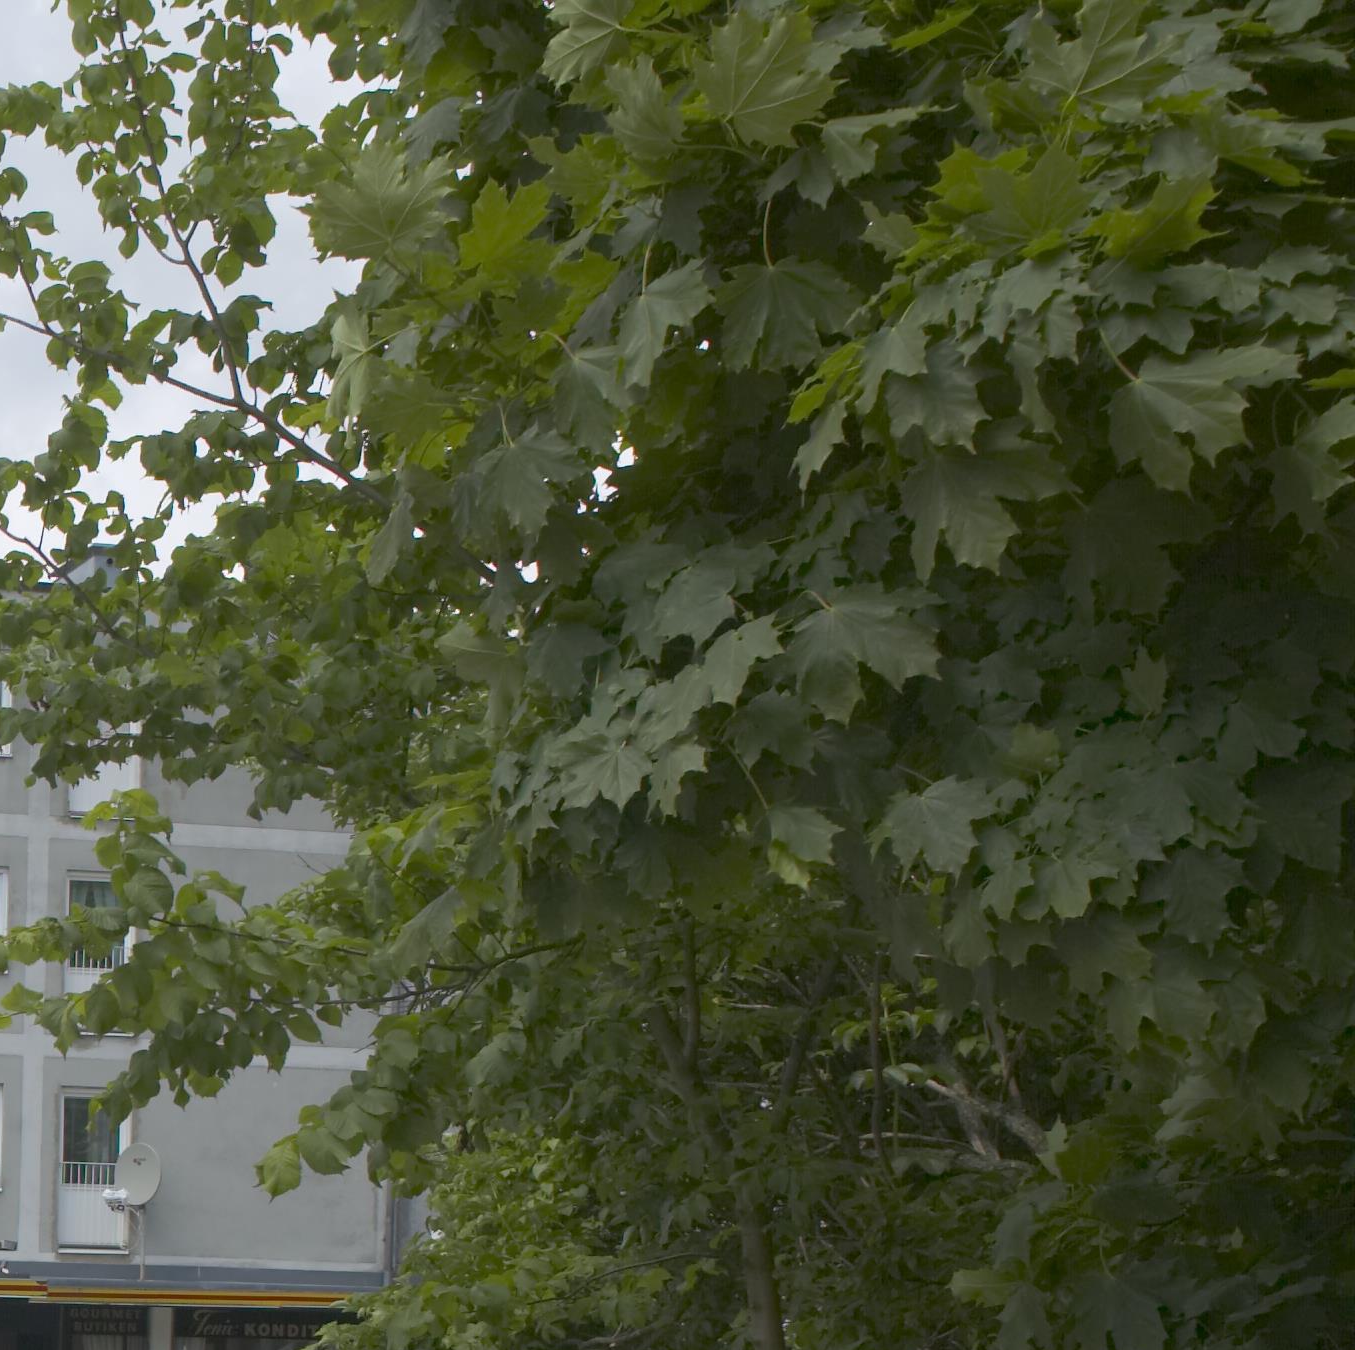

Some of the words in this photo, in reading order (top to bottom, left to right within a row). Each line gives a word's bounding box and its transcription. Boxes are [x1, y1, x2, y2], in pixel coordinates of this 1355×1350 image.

[70, 1307, 141, 1320] GOURMET
[73, 1320, 138, 1333] BUTIKEN
[244, 1323, 317, 1338] KONDIT
